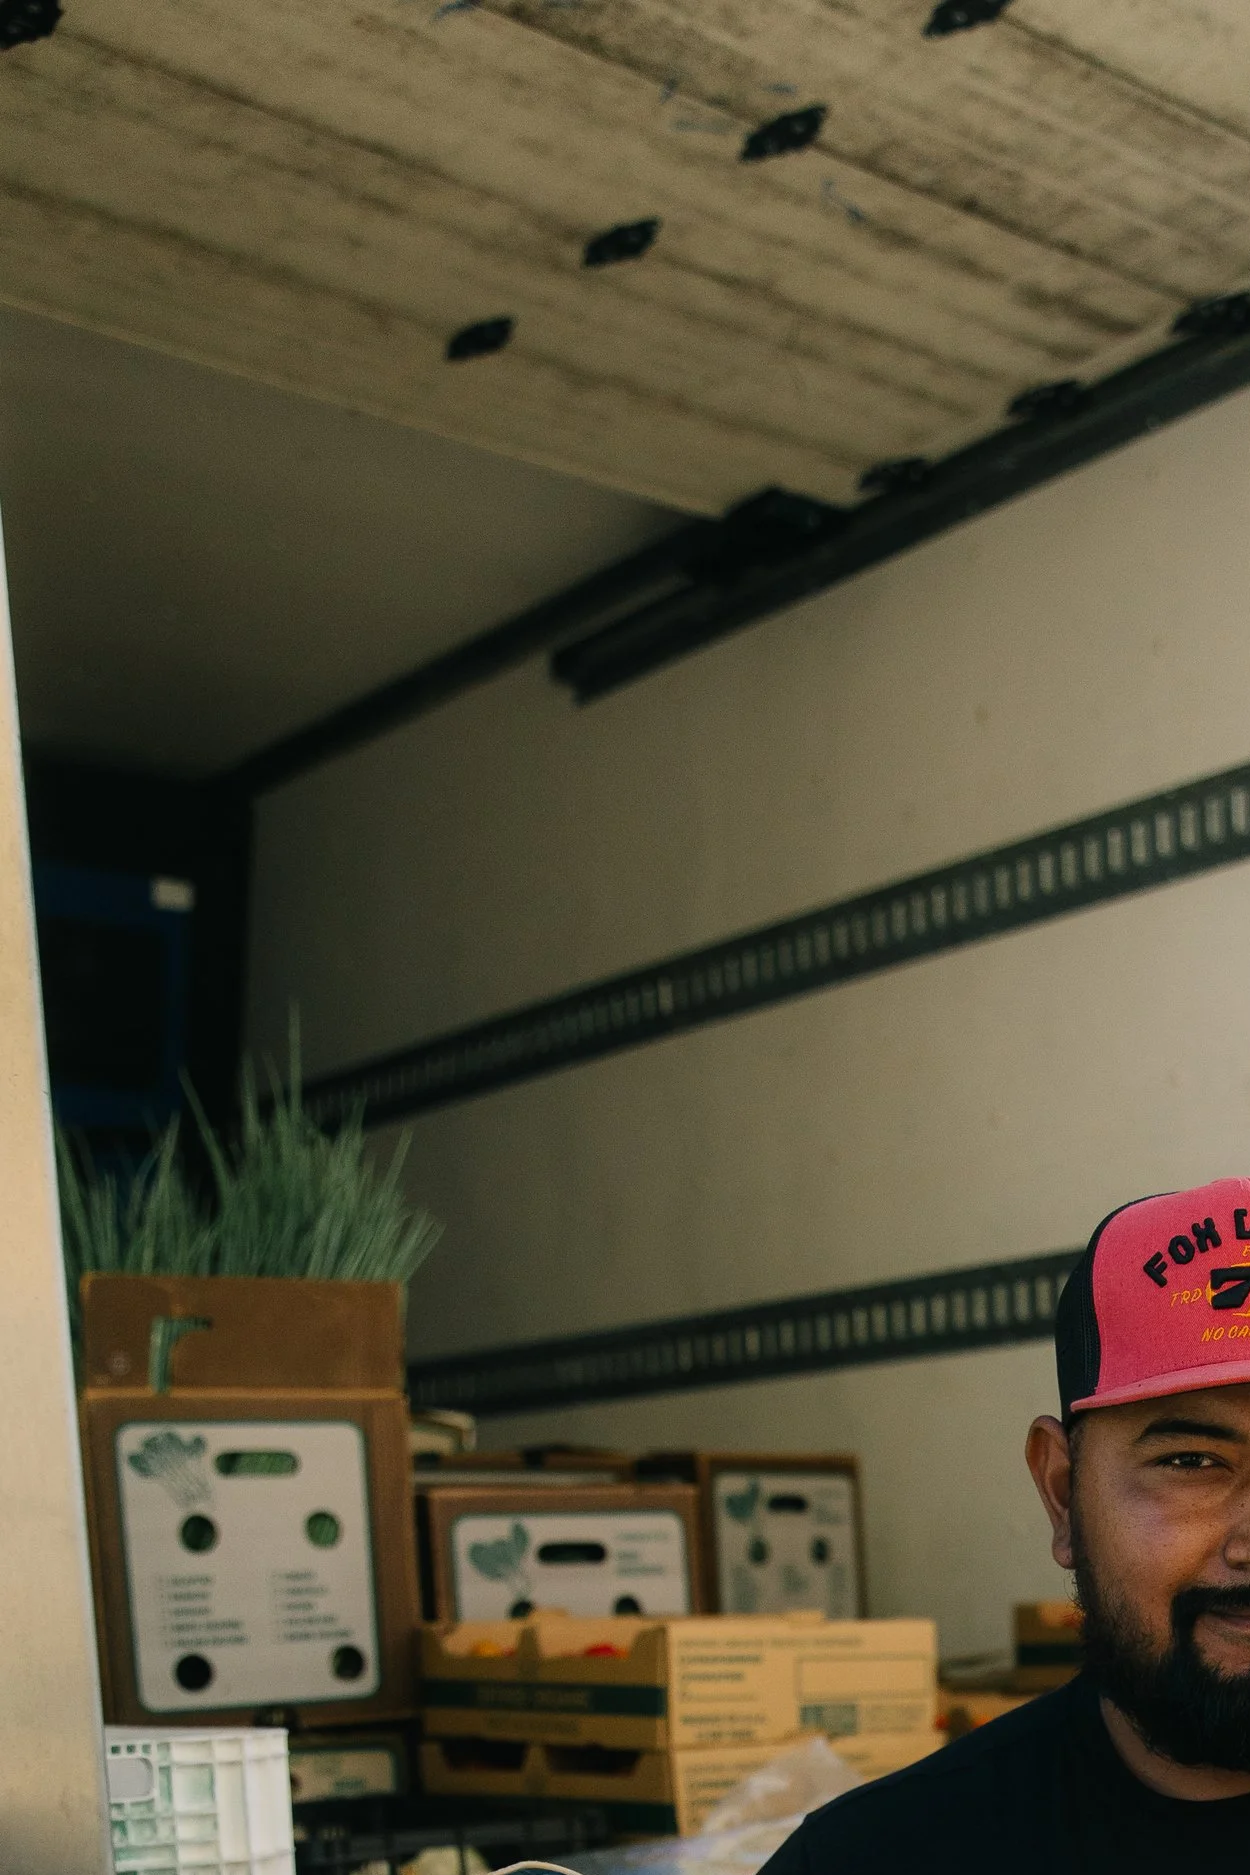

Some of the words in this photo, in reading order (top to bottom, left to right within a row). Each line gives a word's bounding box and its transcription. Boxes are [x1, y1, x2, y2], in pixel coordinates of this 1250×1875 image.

[1143, 1217, 1222, 1288] FOX
[1170, 1288, 1202, 1308] TRD
[1201, 1326, 1225, 1343] NO
